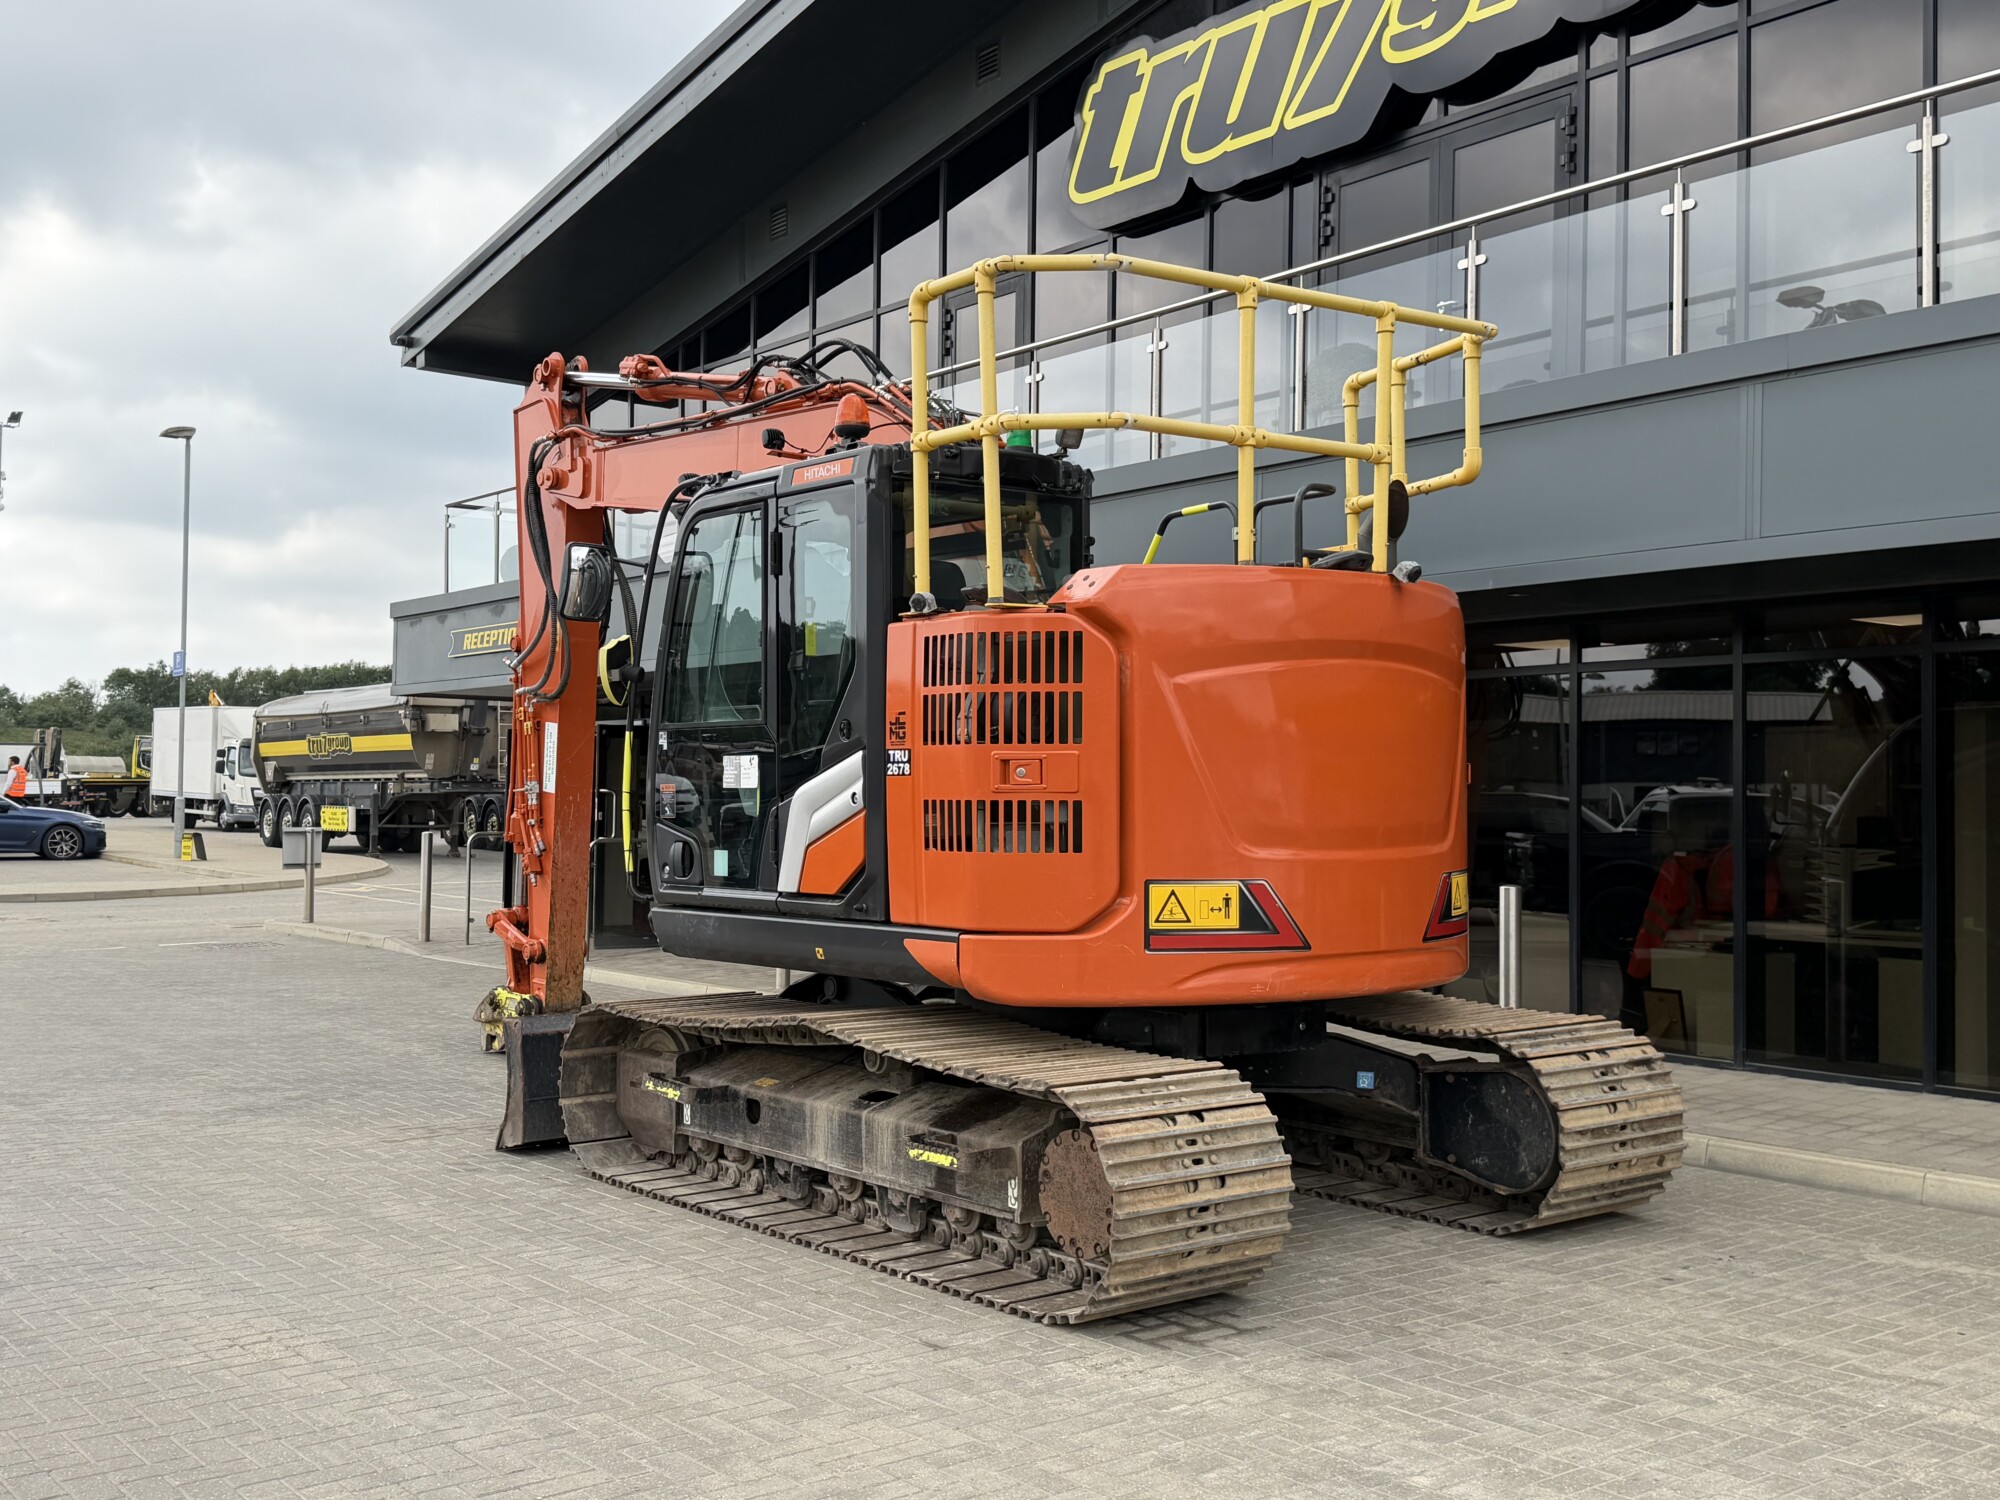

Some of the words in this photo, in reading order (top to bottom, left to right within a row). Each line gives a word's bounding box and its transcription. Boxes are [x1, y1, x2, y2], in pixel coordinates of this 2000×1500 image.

[803, 463, 841, 481] HITACHI
[888, 750, 909, 762] TRU
[886, 763, 910, 775] 2678
